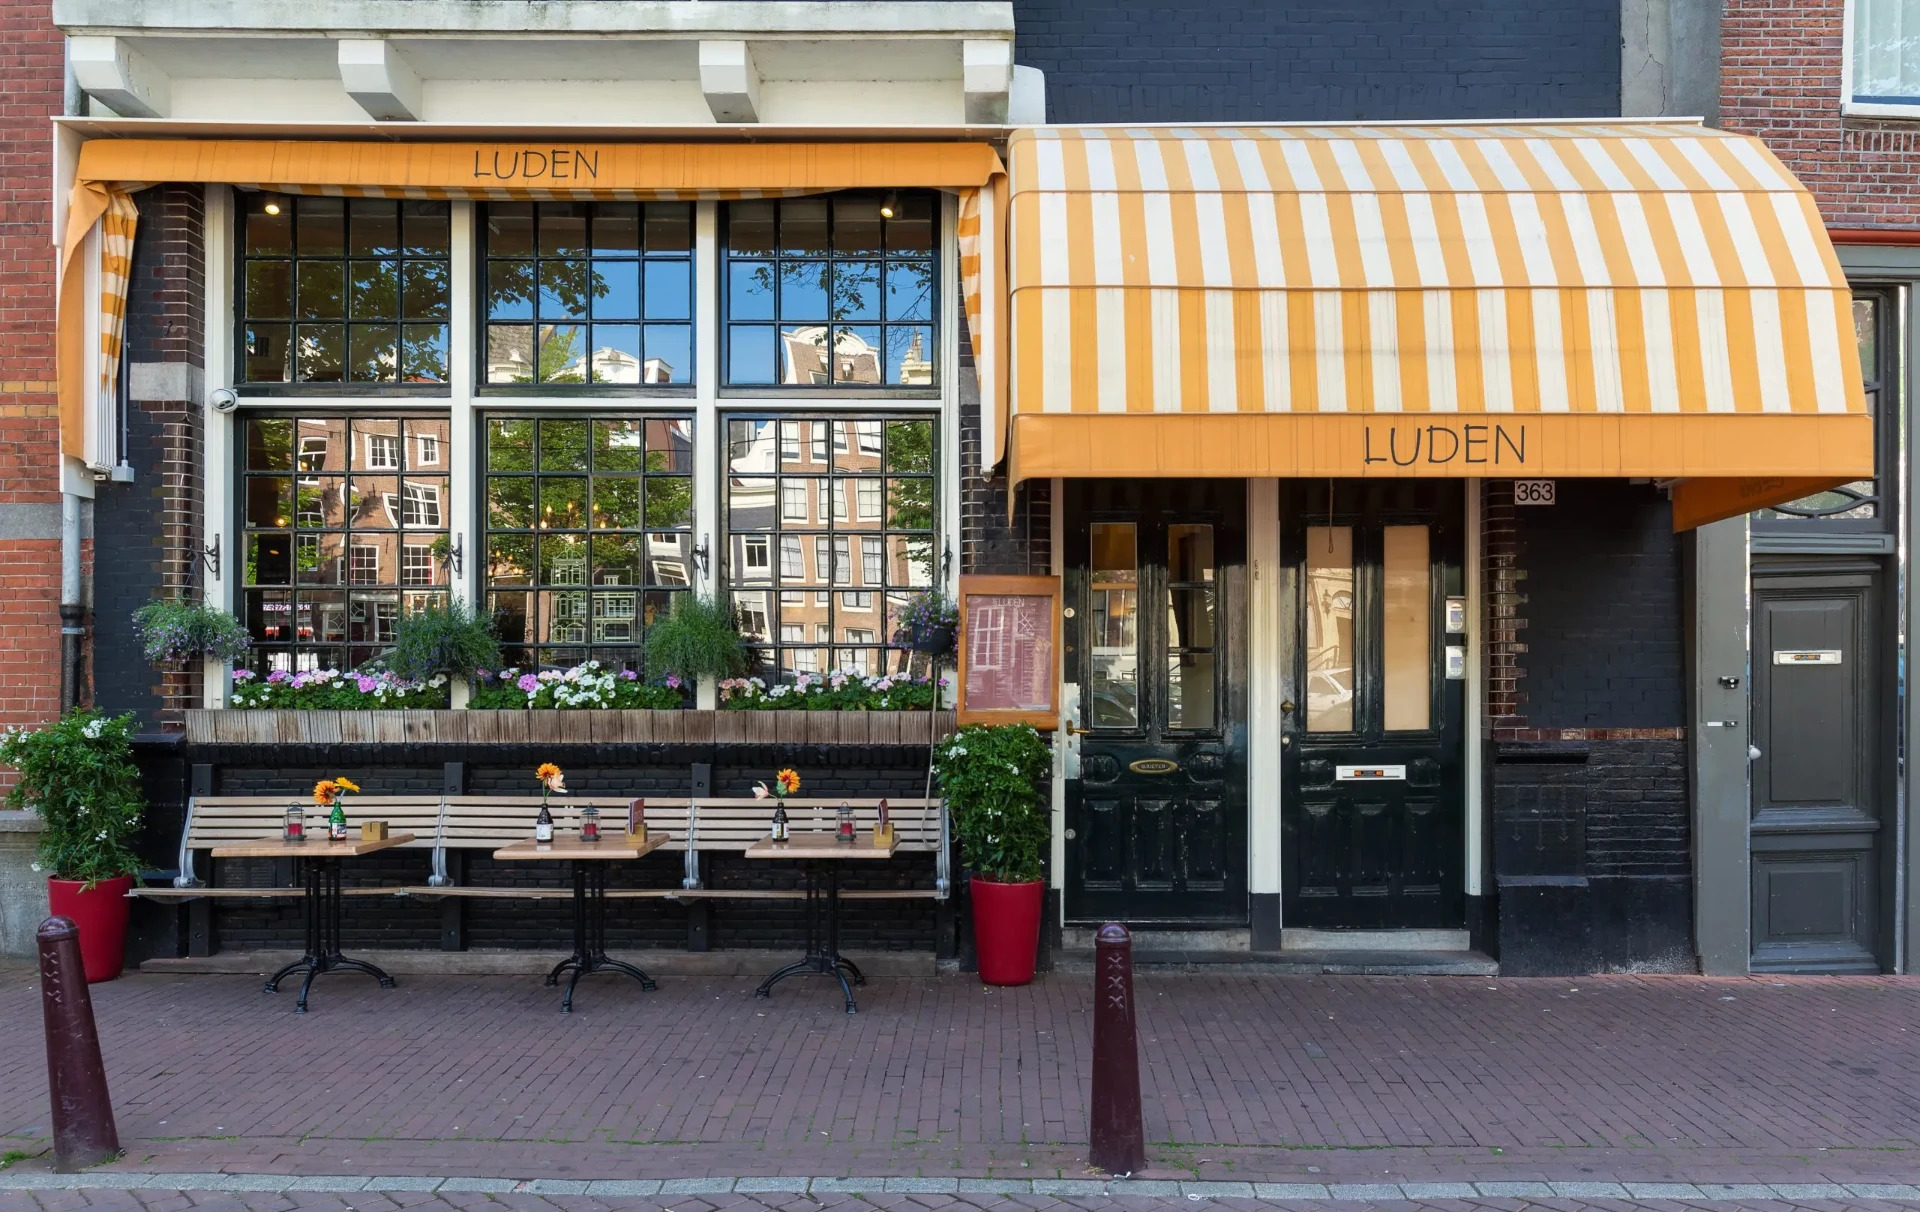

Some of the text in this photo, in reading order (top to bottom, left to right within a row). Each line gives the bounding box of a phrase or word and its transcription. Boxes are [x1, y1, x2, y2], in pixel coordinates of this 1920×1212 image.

[473, 149, 598, 179] LUDEN
[1364, 424, 1524, 466] LUDEN
[1516, 482, 1553, 501] 363
